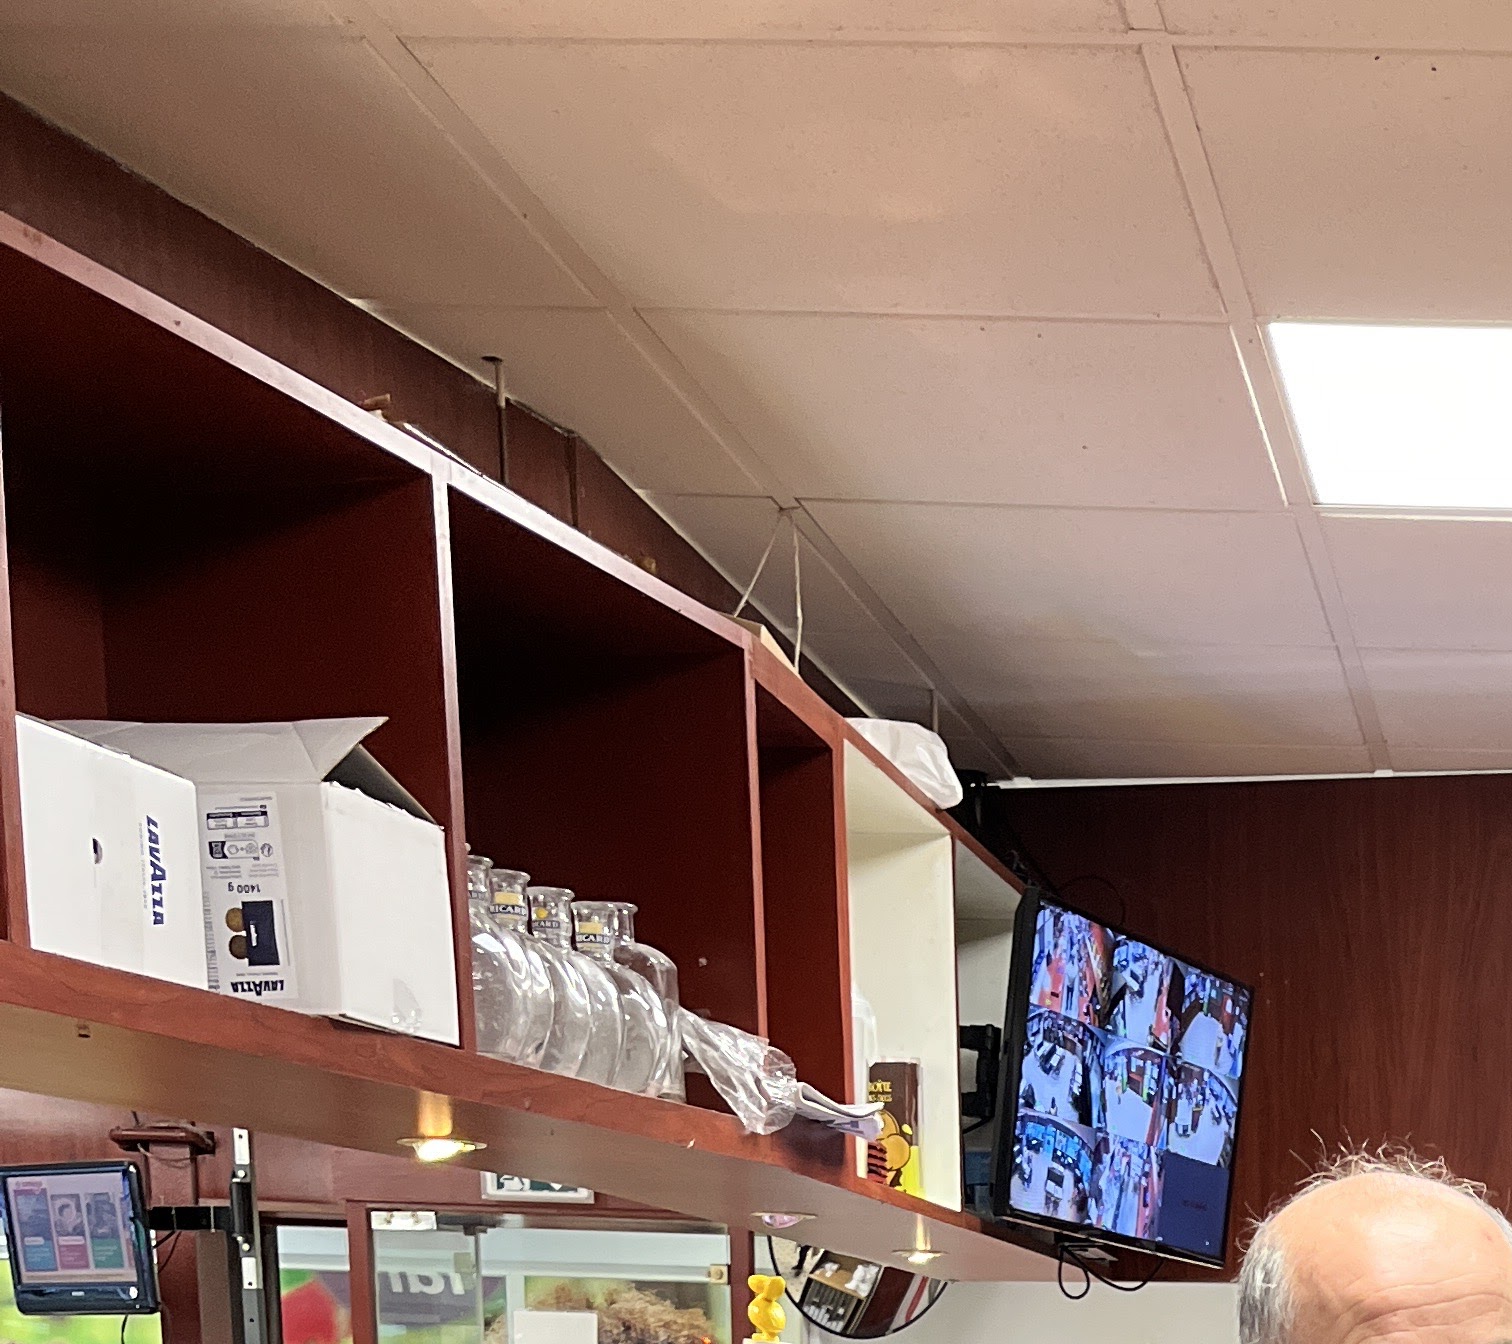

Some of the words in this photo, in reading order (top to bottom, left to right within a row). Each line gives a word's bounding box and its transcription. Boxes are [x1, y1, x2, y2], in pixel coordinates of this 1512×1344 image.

[146, 815, 167, 926] LAVAZZA
[228, 882, 235, 892] g
[236, 883, 261, 893] 1400
[230, 979, 285, 996] LAVAZZA
